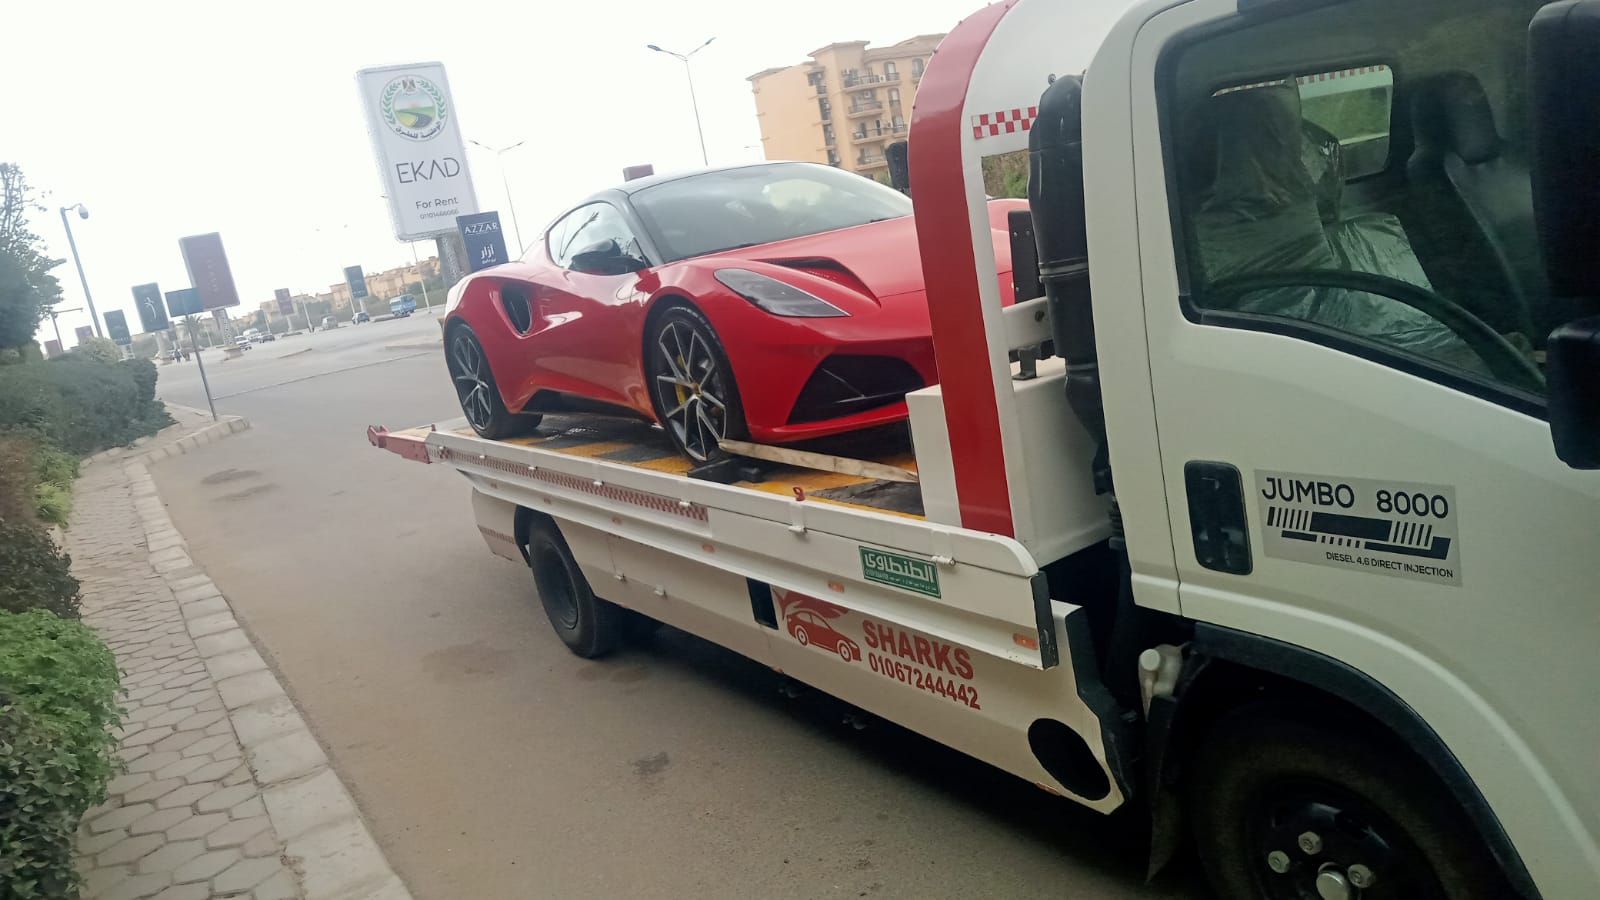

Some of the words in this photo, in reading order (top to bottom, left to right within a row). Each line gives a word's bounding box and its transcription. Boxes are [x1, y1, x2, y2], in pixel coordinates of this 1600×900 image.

[396, 157, 460, 184] EKAD
[415, 200, 432, 209] For
[434, 197, 459, 207] Rent
[464, 222, 499, 234] AZZAR
[1261, 477, 1355, 508] JUMBO
[1376, 490, 1449, 519] 8000
[1325, 551, 1356, 564] DIESEL
[1371, 558, 1402, 571] DIRECT
[1404, 563, 1453, 578] INJECTION
[862, 619, 974, 680] SHARKS
[868, 652, 981, 710] 01067244442
